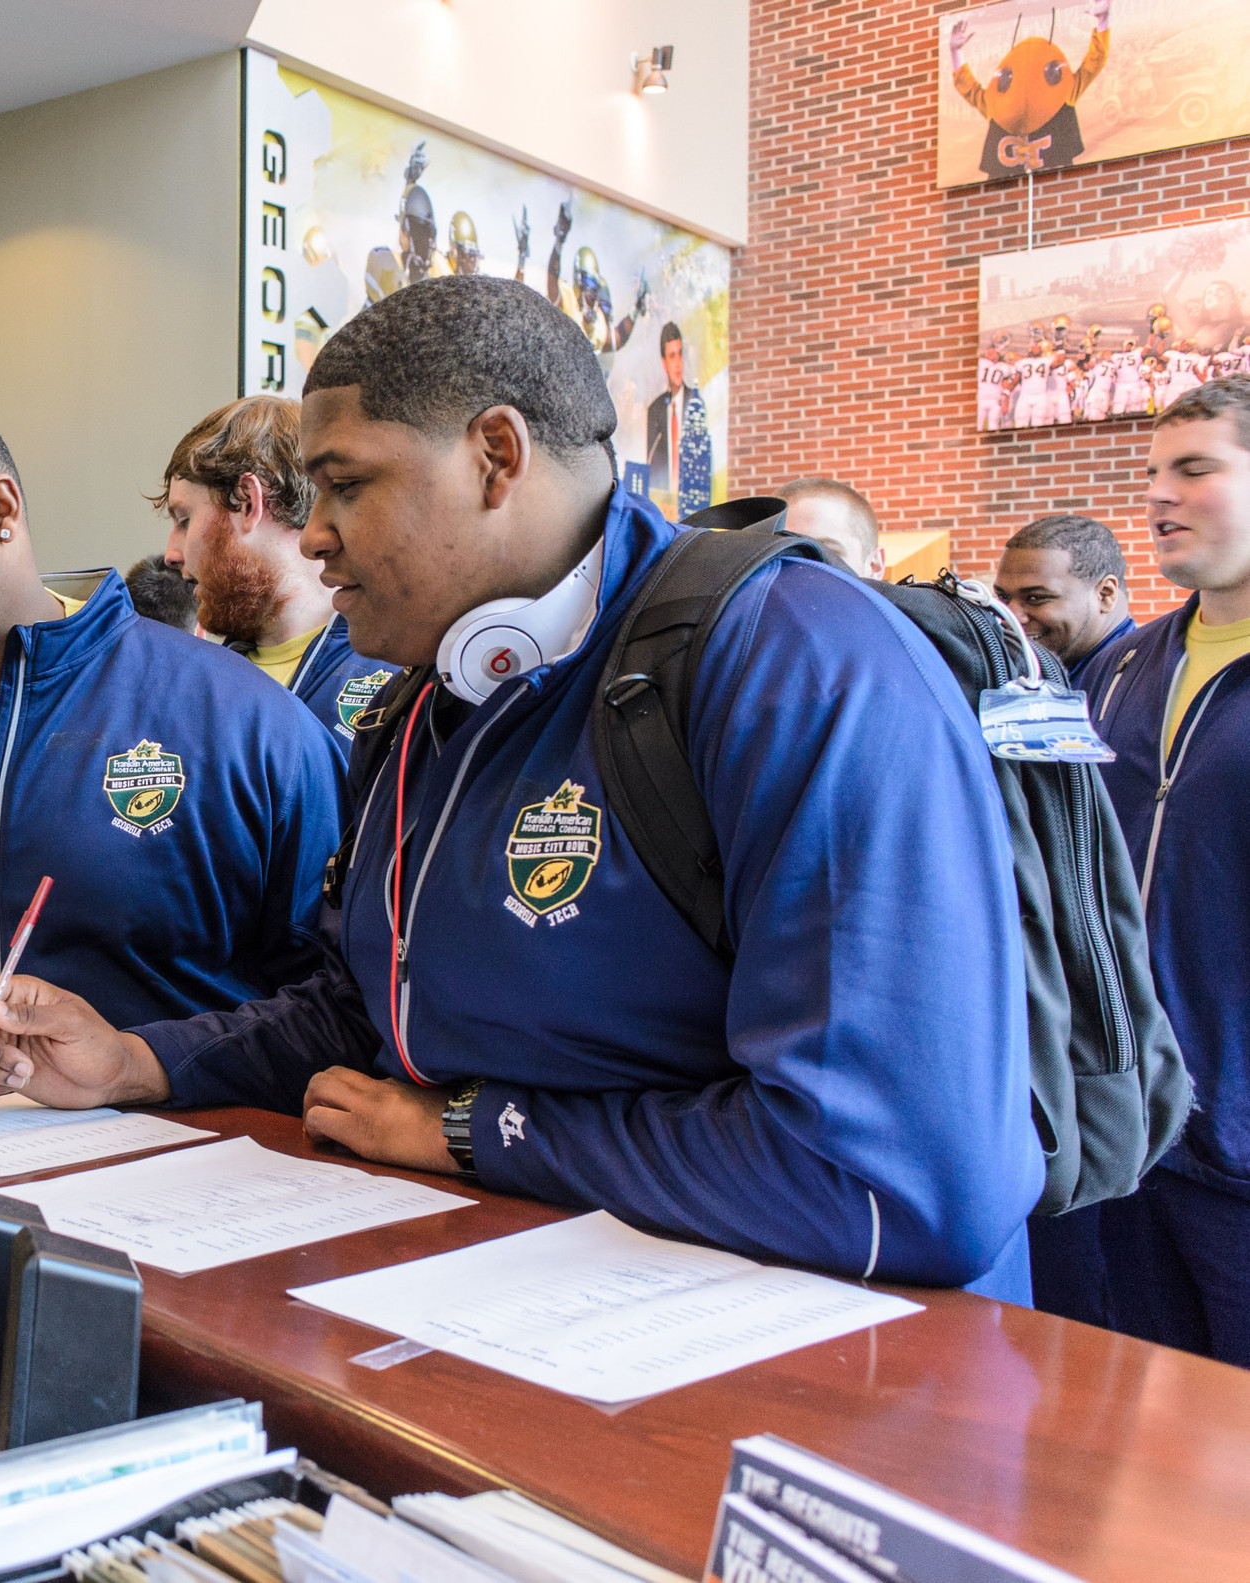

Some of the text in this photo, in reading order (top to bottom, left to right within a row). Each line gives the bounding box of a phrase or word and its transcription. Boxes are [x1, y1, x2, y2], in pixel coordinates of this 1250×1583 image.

[1023, 363, 1046, 380] 34
[114, 760, 141, 768] Franklin
[112, 776, 176, 788] MUSIC CITY BOWL
[524, 812, 592, 825] Franklin American
[111, 817, 174, 838] GEORGIA TECH
[521, 824, 591, 834] MORTGAGE COMPANY
[515, 842, 589, 854] MUSIC CITY BOWL
[504, 895, 580, 928] GEORGIA TECH
